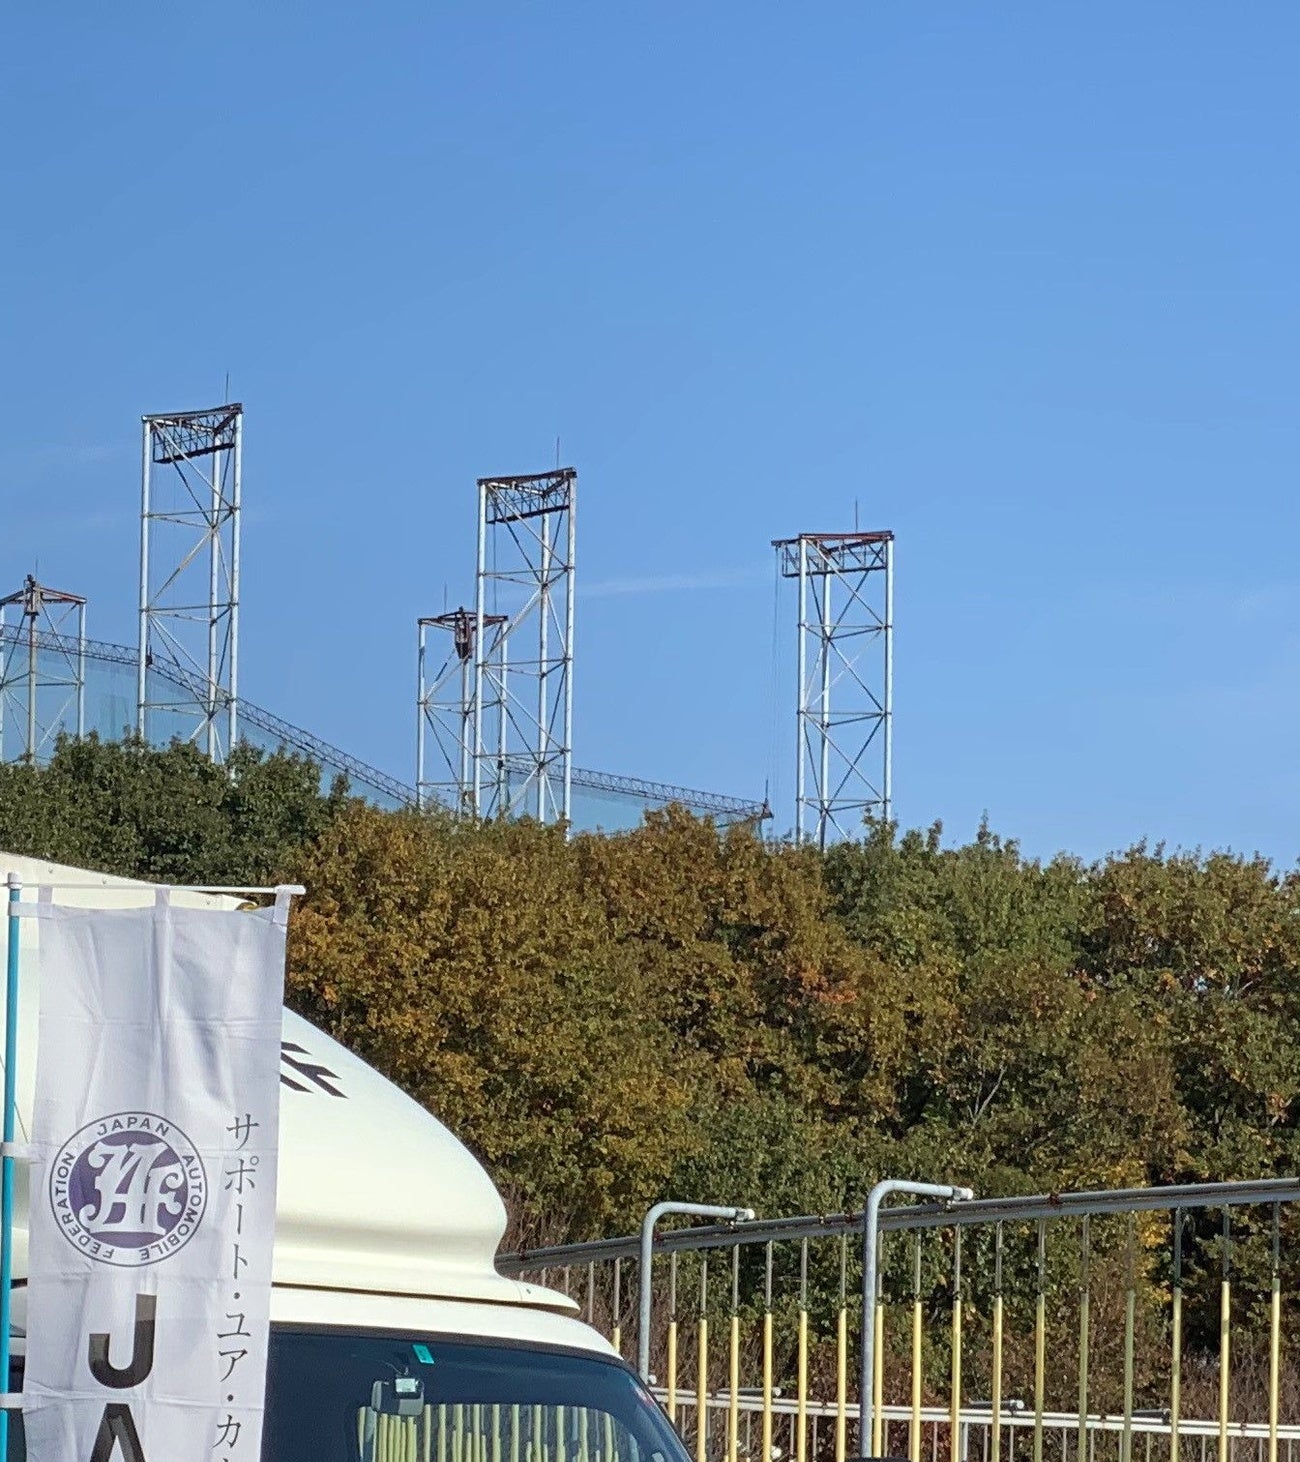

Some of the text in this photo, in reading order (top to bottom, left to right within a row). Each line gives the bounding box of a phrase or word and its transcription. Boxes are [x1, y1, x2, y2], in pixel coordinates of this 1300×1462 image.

[54, 1115, 202, 1261] JAPAN AUTOMOBILE FEDERATION
